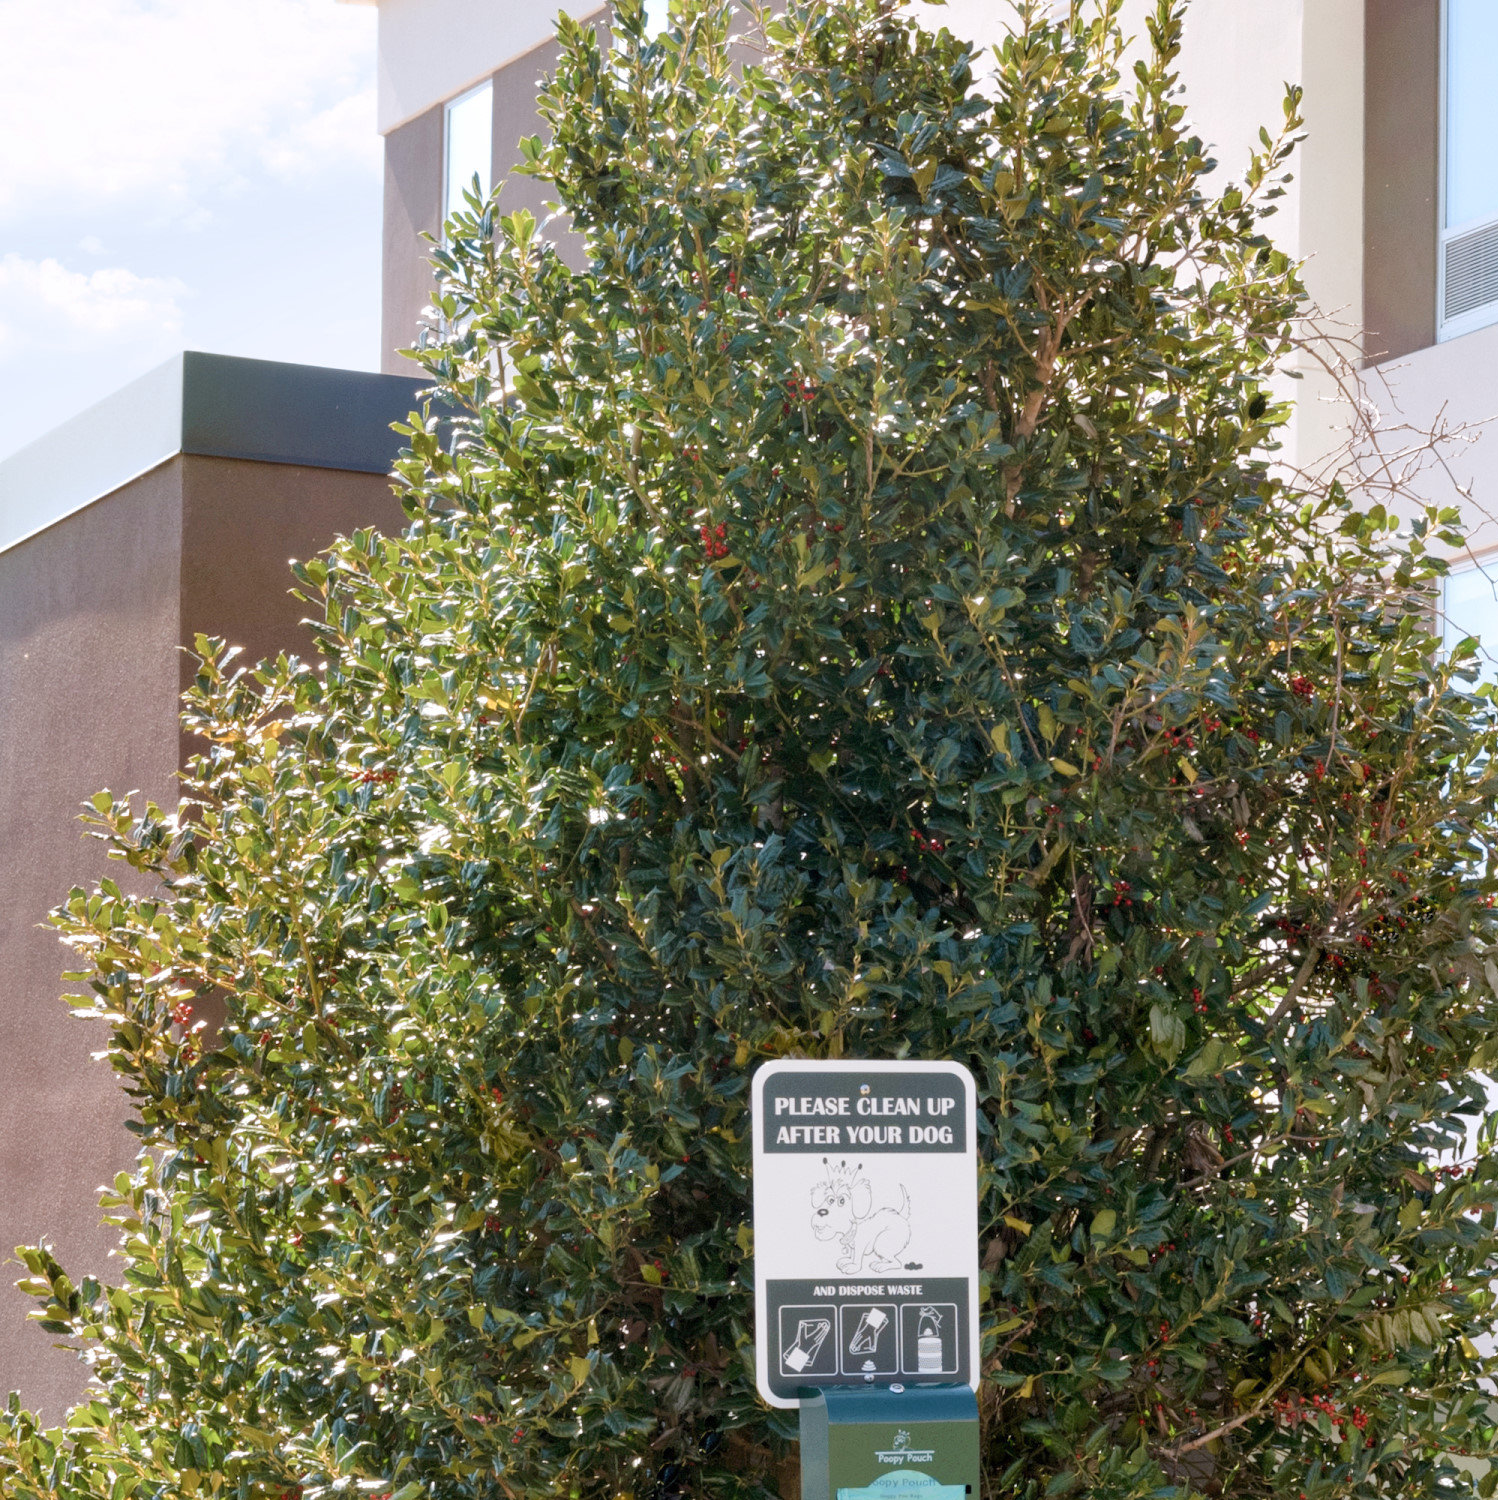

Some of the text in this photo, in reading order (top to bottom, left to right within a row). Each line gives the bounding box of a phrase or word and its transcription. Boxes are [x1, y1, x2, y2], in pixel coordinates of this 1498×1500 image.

[775, 1097, 955, 1115] PLEASE CLEAN UP
[777, 1126, 953, 1144] AFTER YOUR DOG
[813, 1284, 923, 1296] AND DISPOSE WASTE
[878, 1453, 932, 1465] Poopy Pouch
[873, 1478, 936, 1488] oopy Pouch
